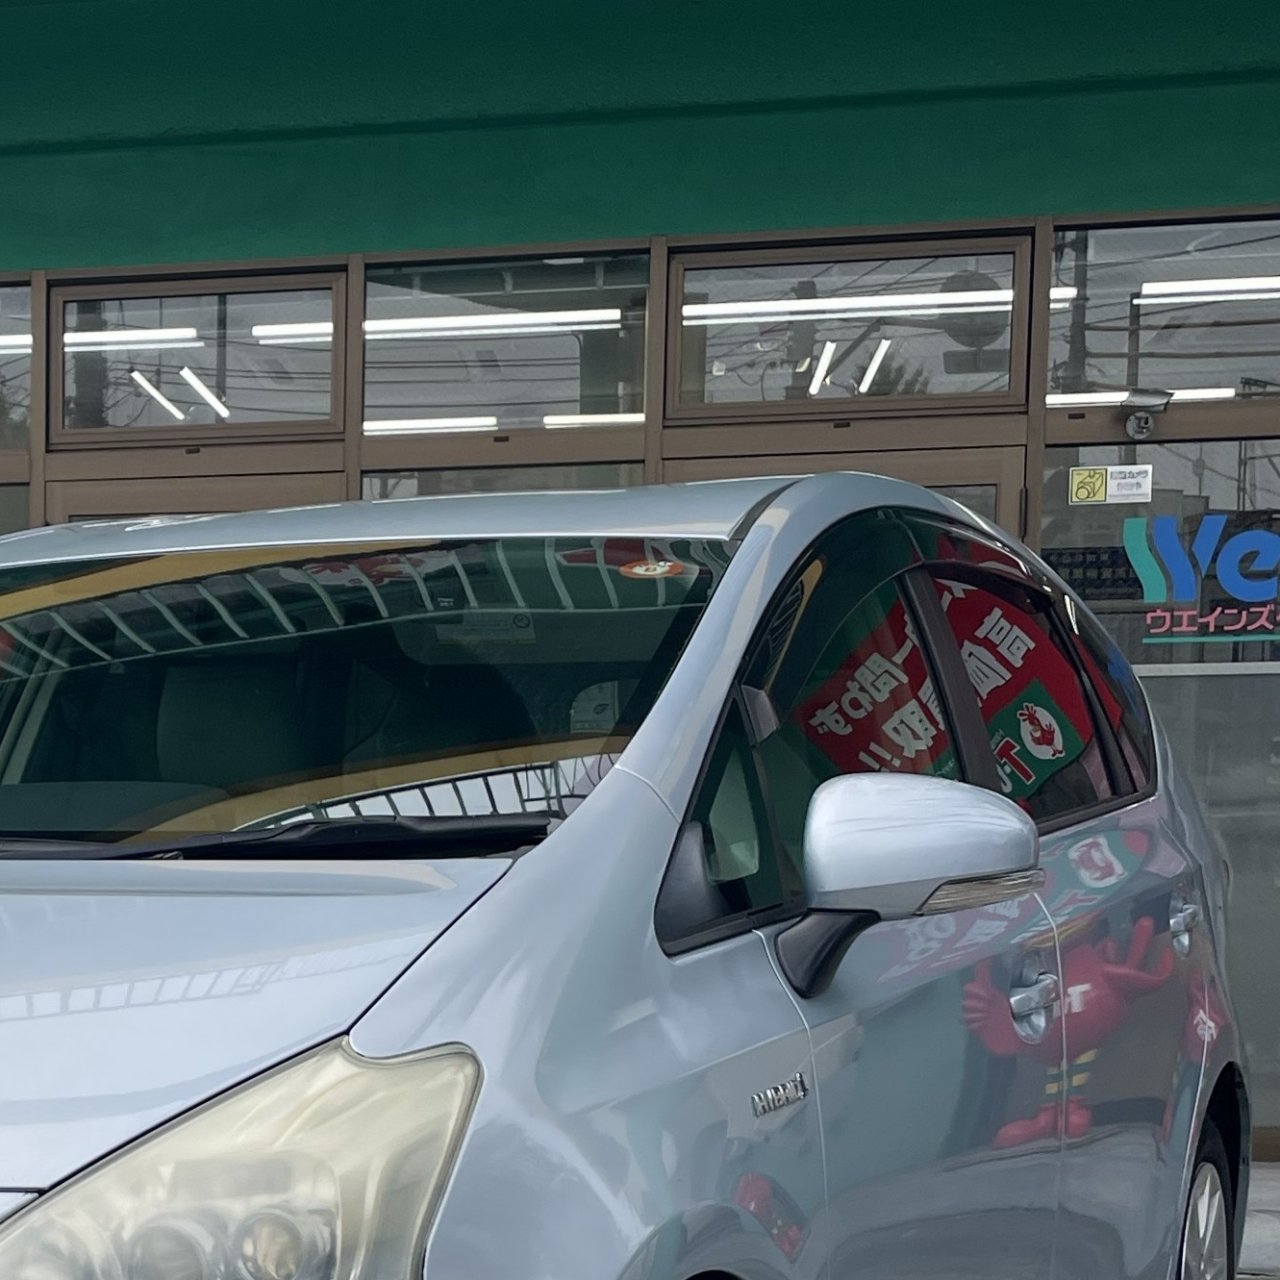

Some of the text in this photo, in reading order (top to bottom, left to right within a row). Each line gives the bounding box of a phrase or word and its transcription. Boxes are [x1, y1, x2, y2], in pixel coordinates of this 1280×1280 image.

[1146, 604, 1280, 633] ウエインズ
